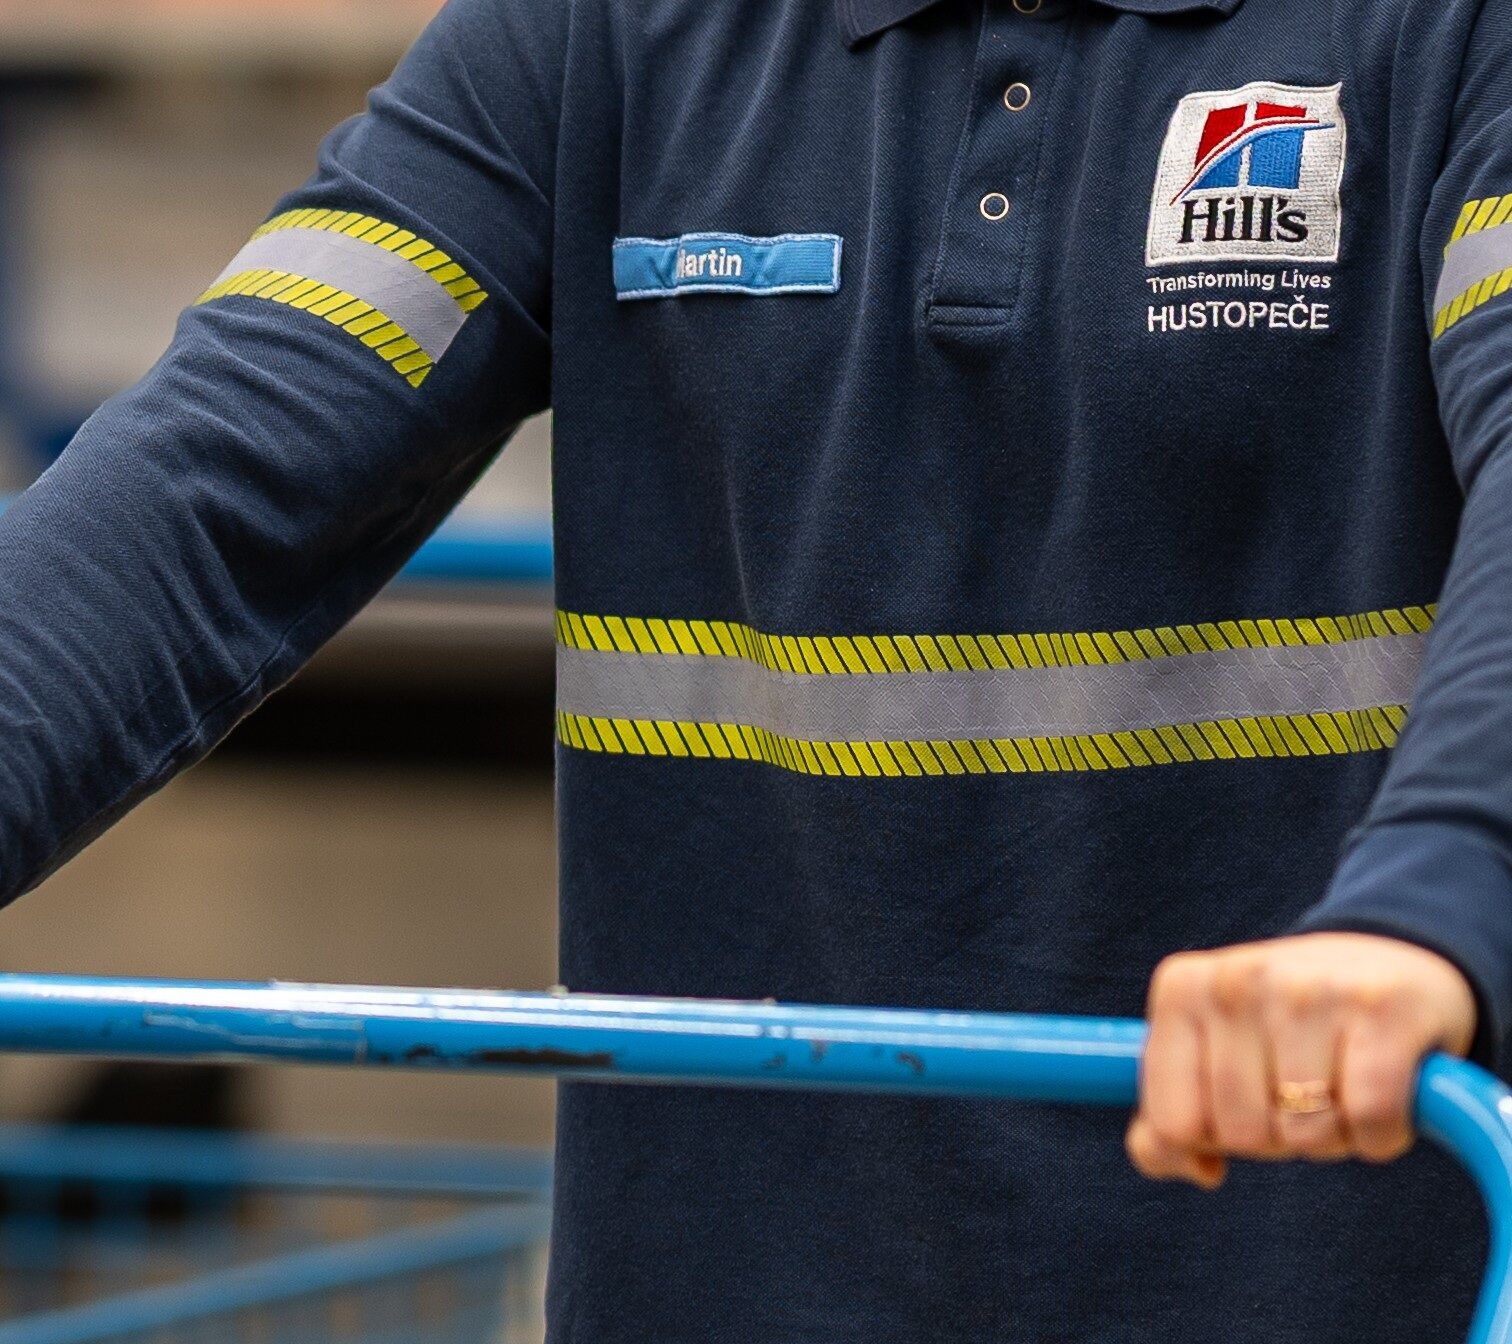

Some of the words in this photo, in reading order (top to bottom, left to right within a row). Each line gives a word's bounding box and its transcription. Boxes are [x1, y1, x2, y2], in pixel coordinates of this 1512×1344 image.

[1177, 195, 1309, 244] Hill's
[1146, 269, 1276, 294] Transforming
[1281, 268, 1332, 289] Lives
[1147, 294, 1330, 333] HUSTOPEČE
